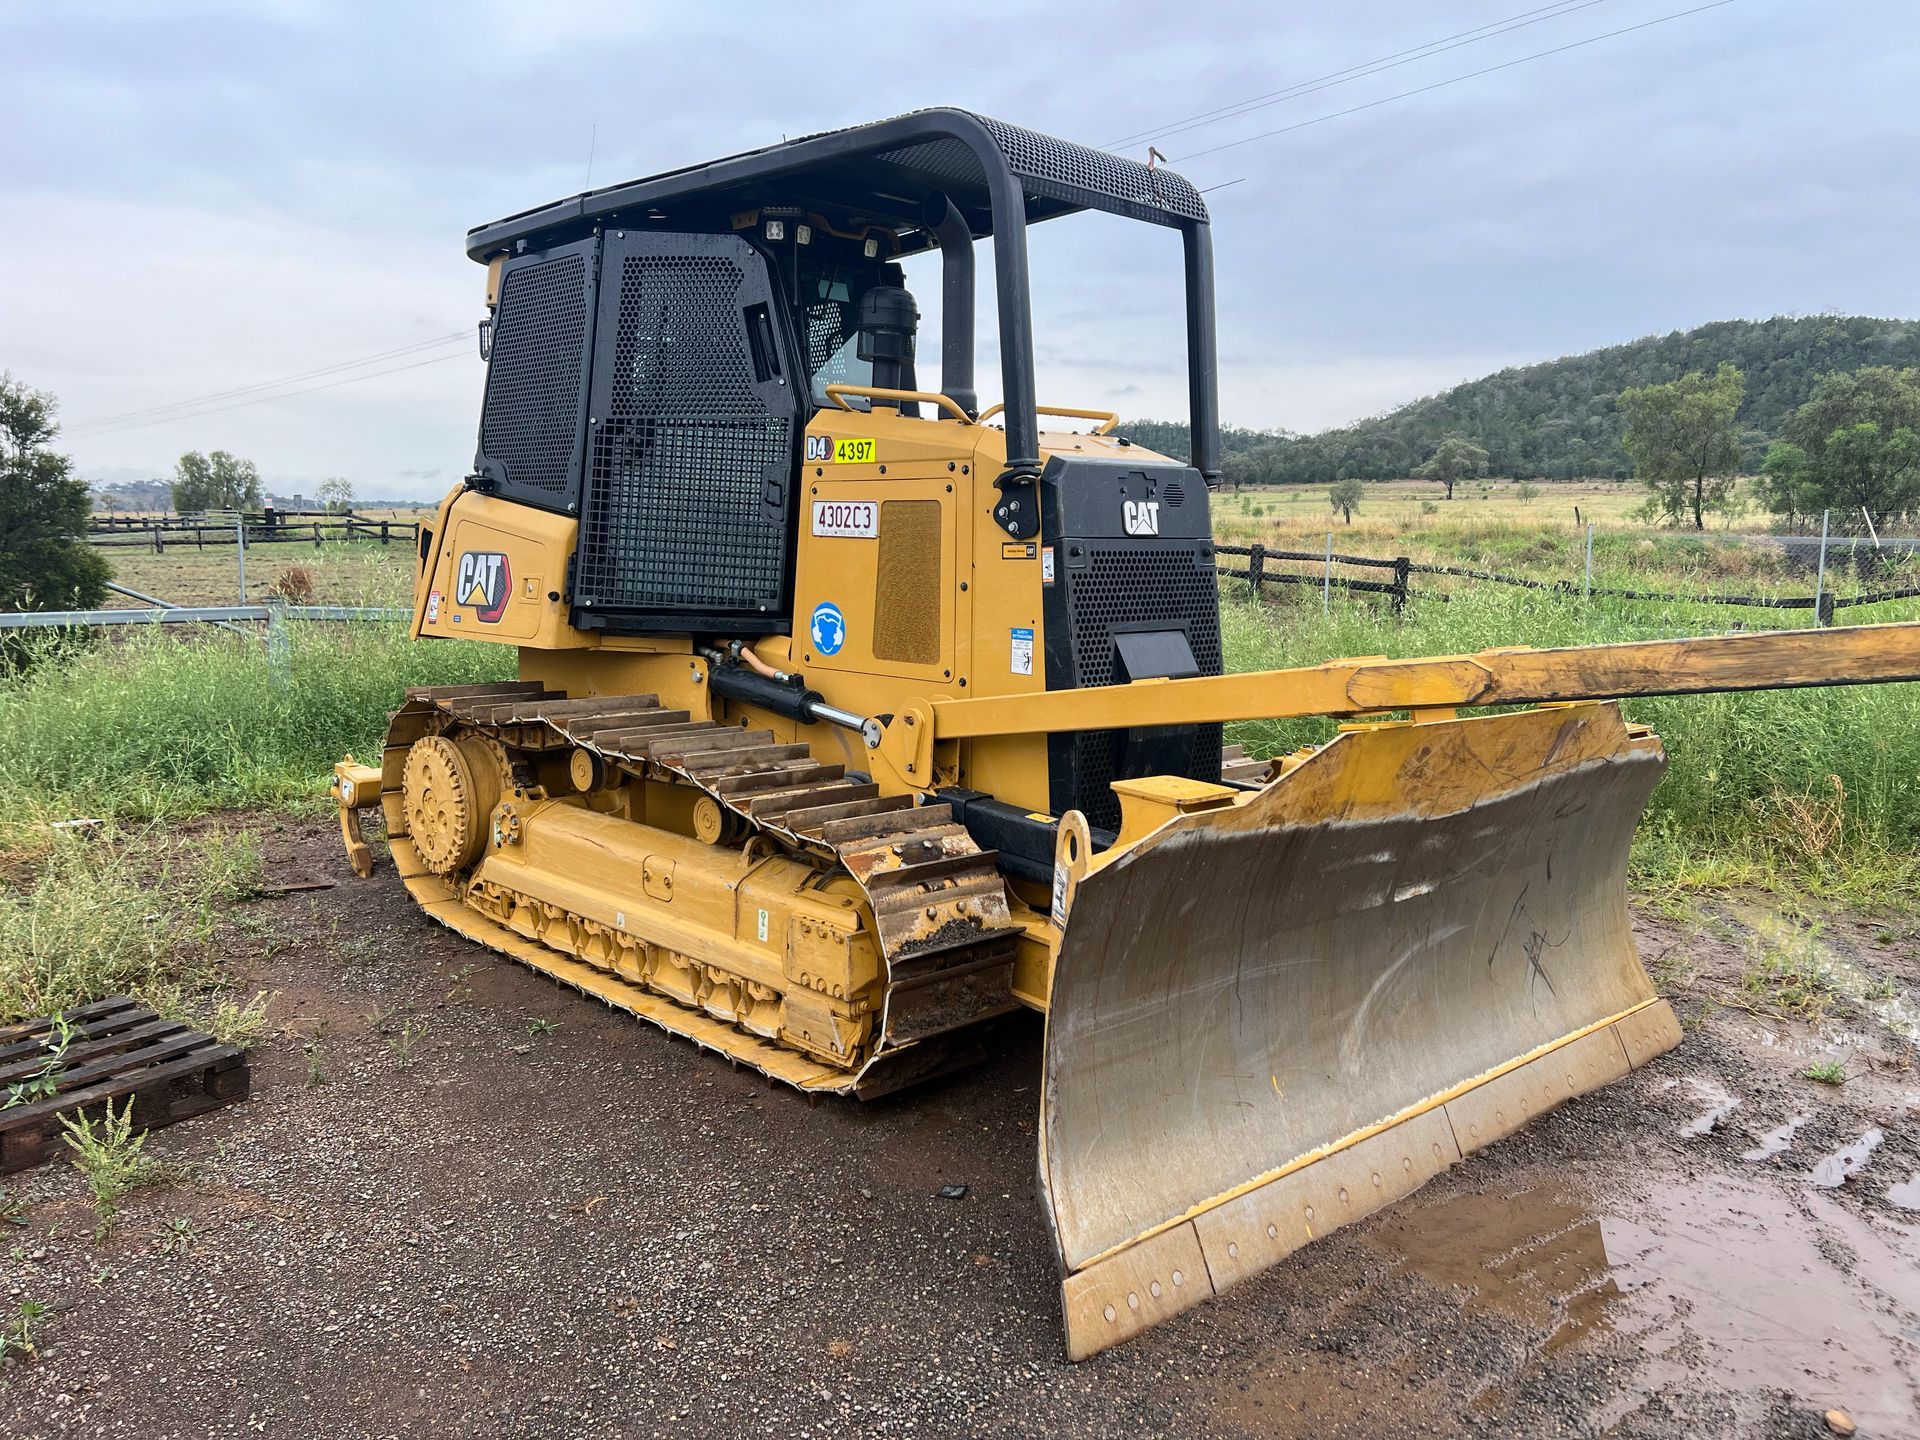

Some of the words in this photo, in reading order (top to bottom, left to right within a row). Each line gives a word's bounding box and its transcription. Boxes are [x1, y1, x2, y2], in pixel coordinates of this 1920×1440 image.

[807, 437, 826, 459] D4
[838, 442, 872, 460] 4397
[819, 505, 871, 528] 4302C3
[1124, 500, 1159, 535] CAT
[457, 553, 502, 606] CAT
